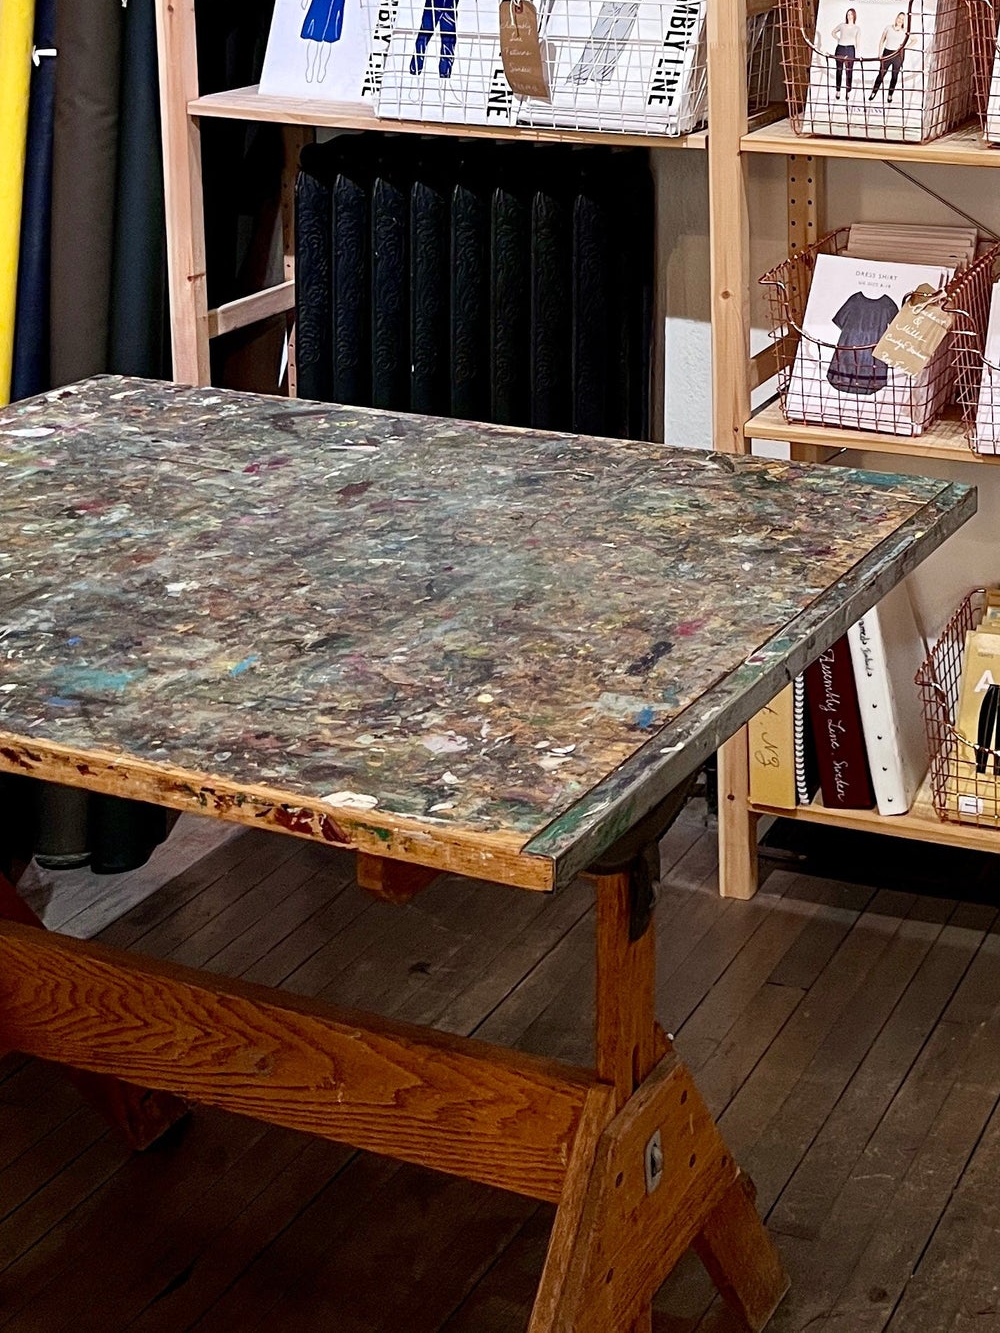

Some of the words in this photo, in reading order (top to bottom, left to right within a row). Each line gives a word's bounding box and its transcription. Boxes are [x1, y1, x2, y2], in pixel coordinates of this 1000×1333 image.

[486, 69, 514, 118] LINE
[648, 58, 684, 107] LINE
[855, 270, 876, 278] DRESS
[819, 648, 841, 713] Assembly
[831, 761, 850, 803] Sweden
